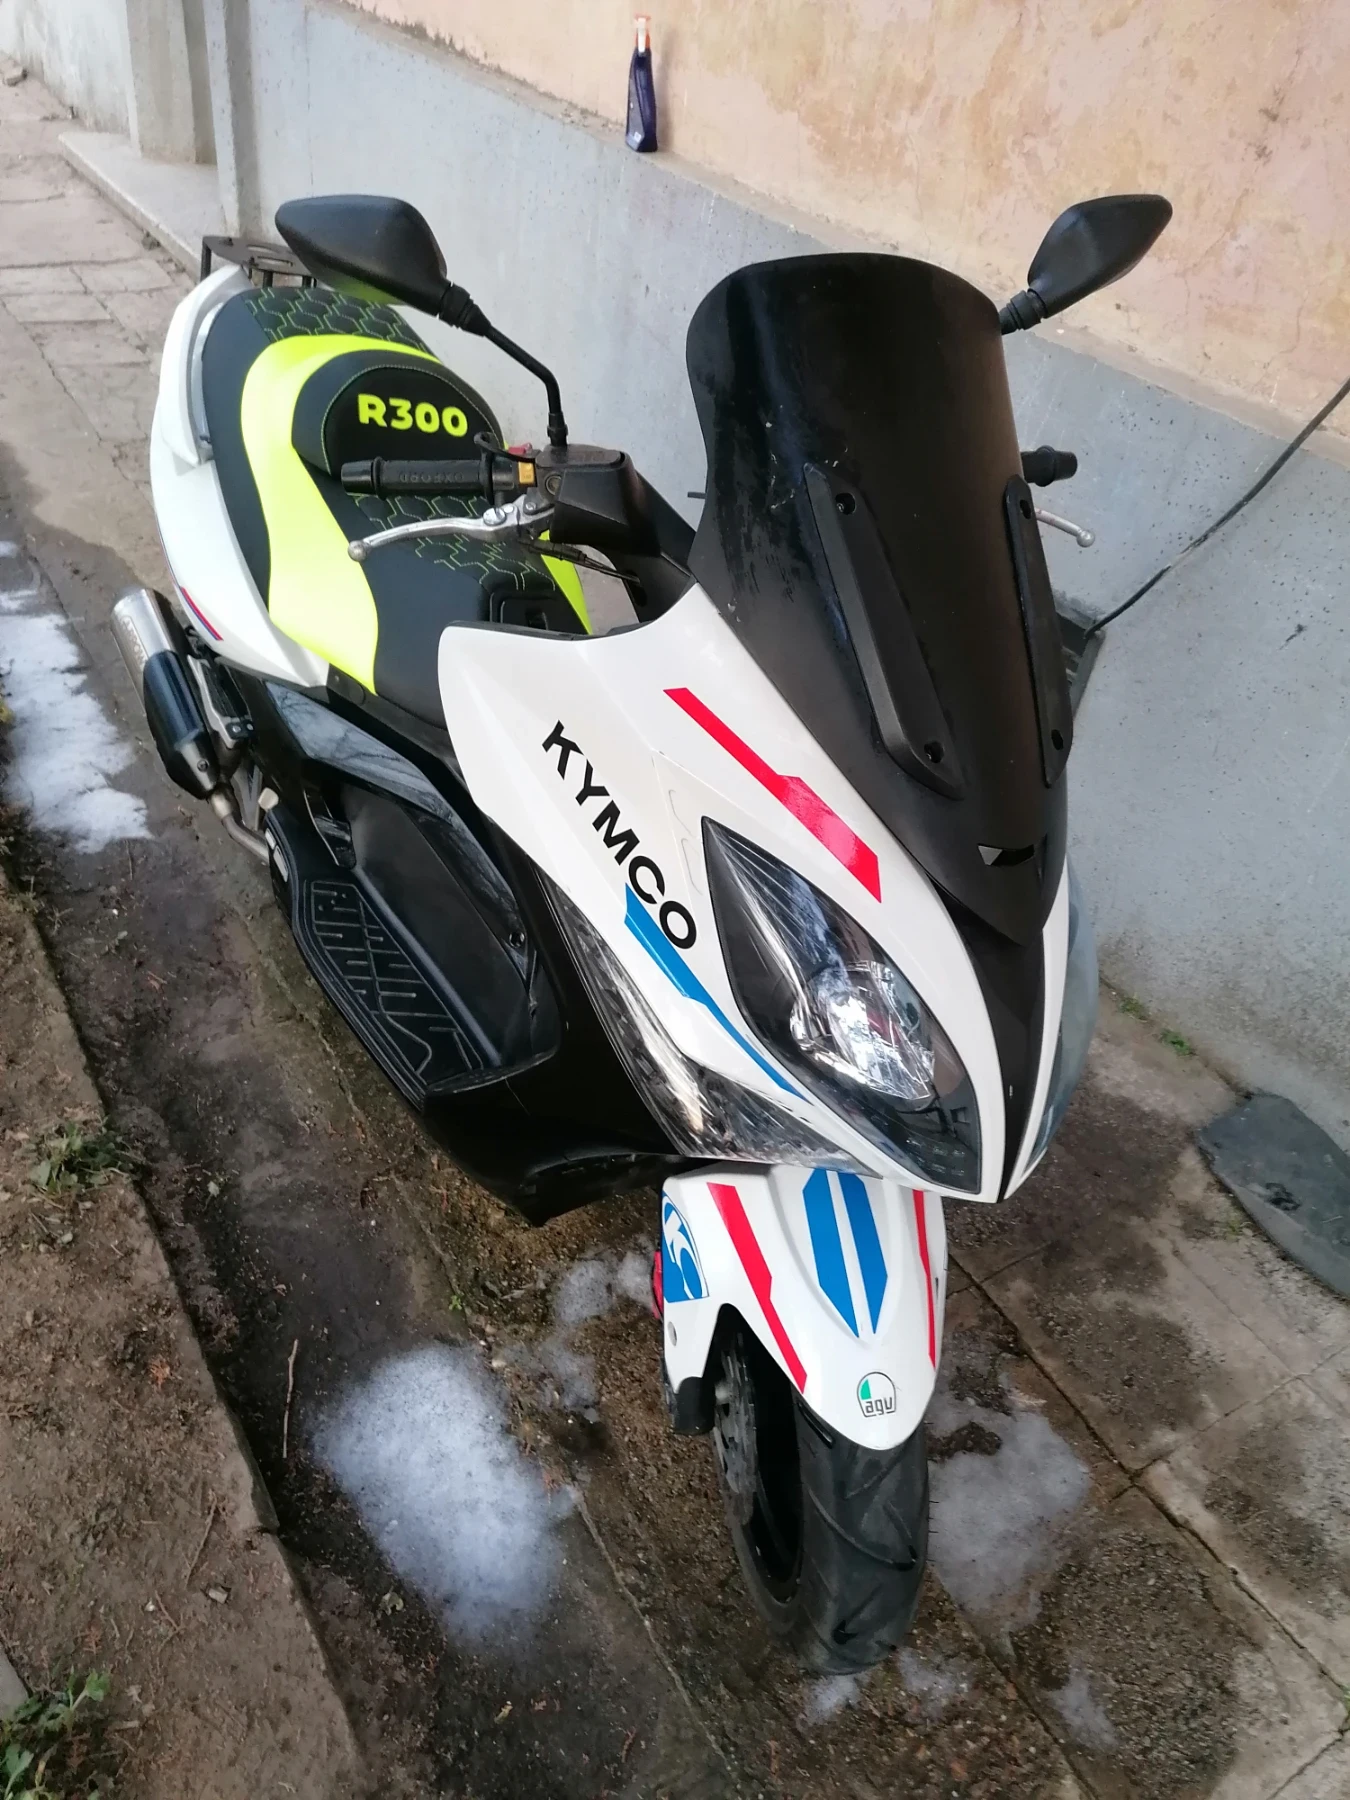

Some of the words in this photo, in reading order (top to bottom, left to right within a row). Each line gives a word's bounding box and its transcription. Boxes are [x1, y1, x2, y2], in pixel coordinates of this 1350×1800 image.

[358, 393, 468, 437] R300
[399, 472, 465, 484] OXFORD
[541, 719, 697, 950] KYMCO
[865, 1396, 893, 1415] agv
